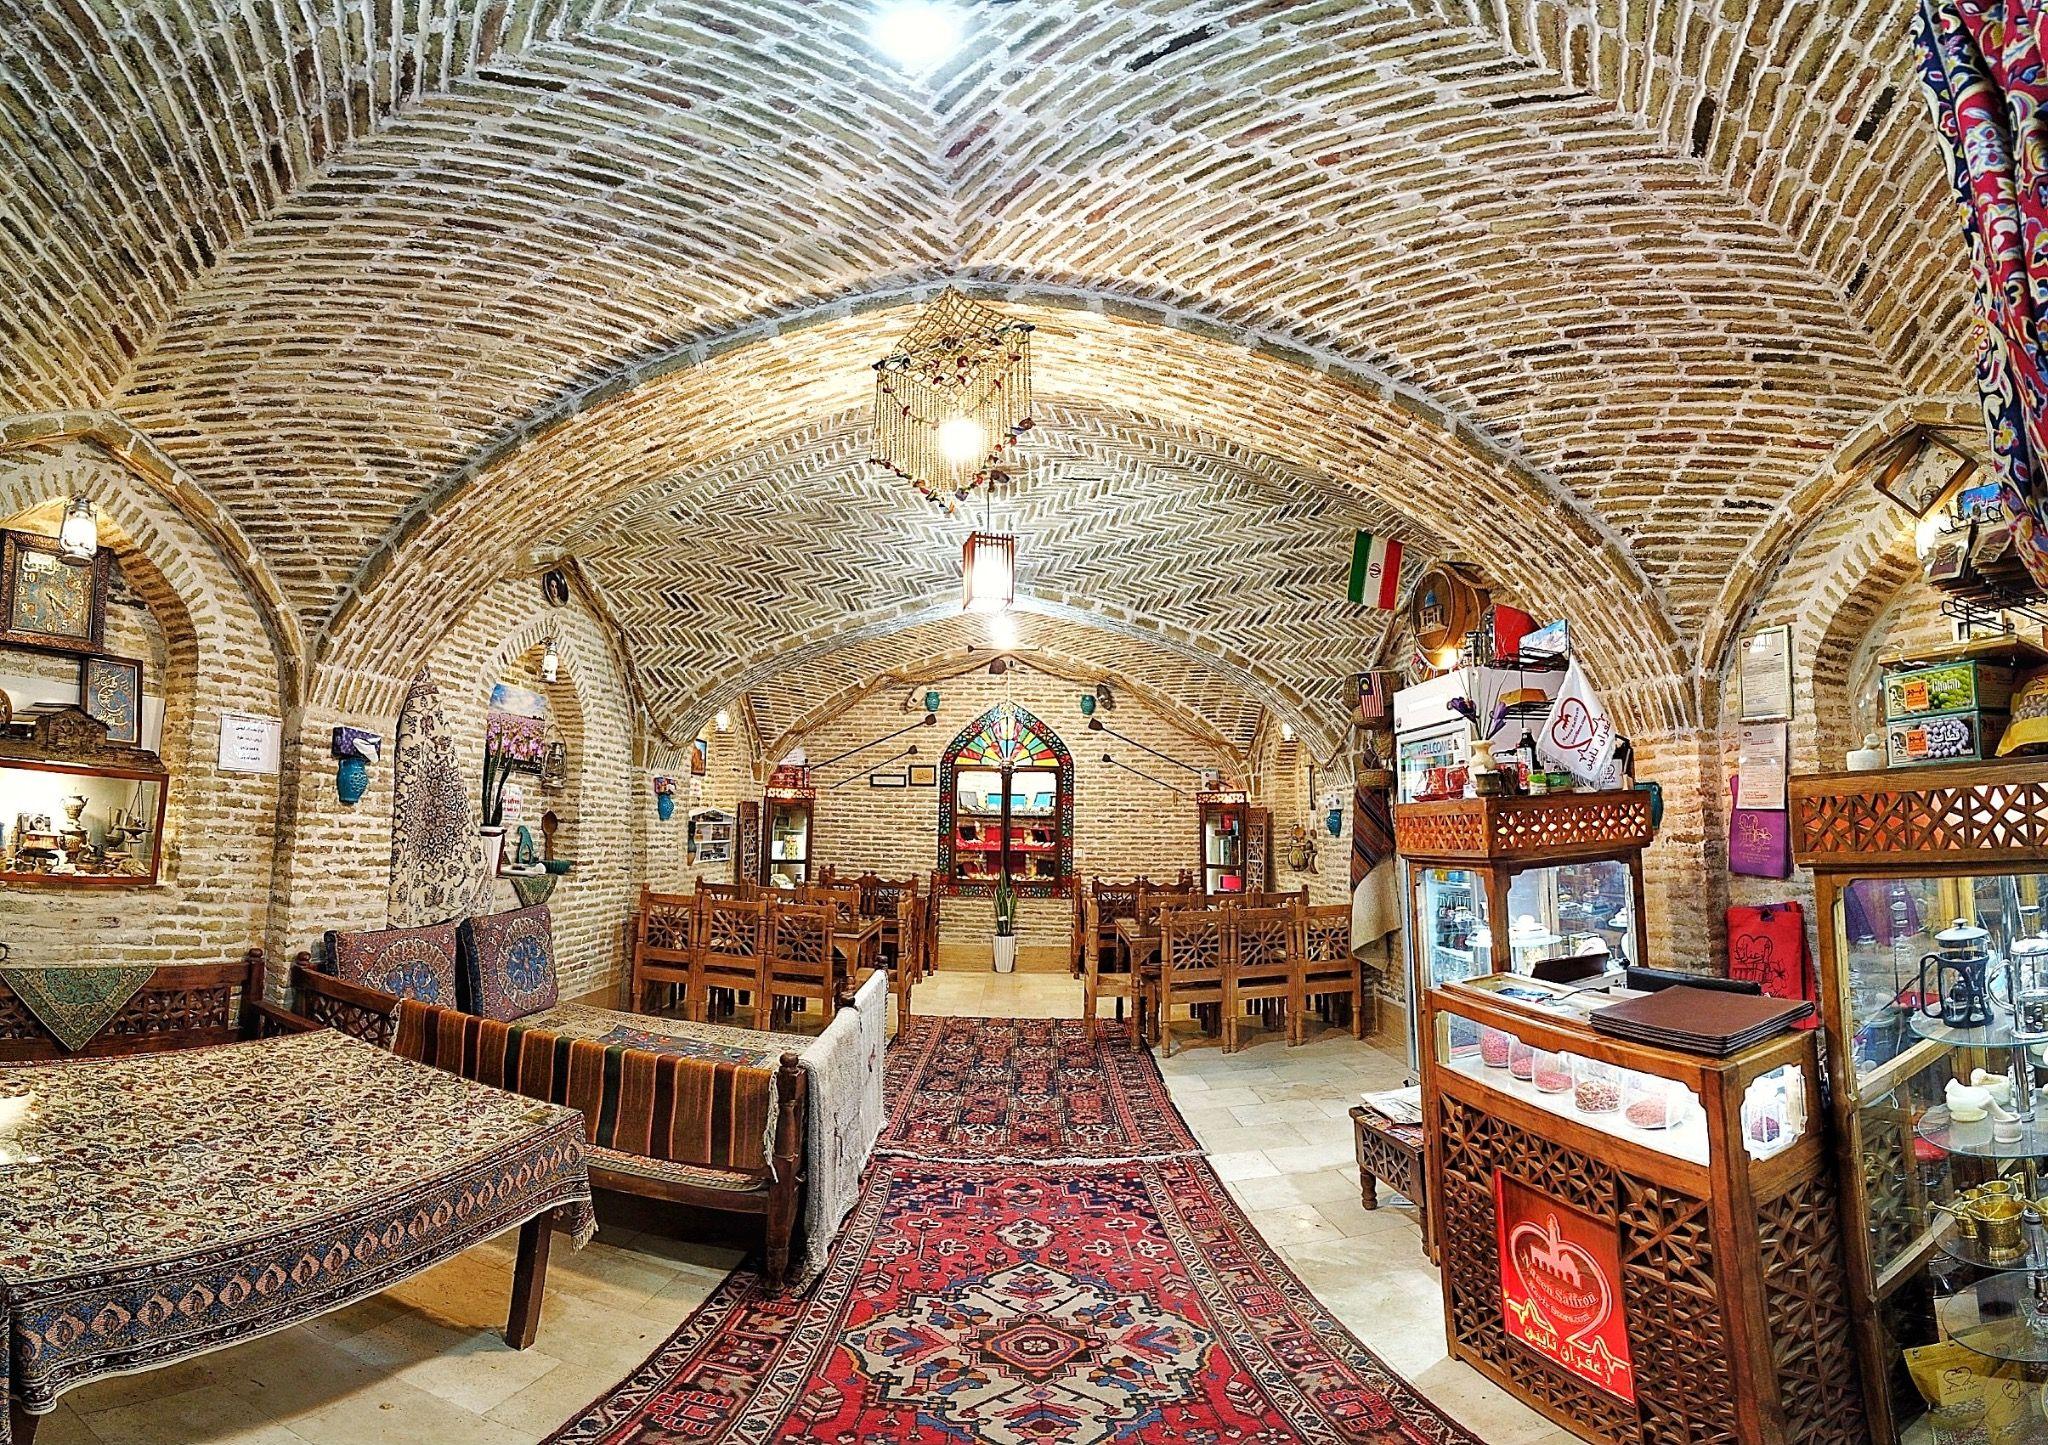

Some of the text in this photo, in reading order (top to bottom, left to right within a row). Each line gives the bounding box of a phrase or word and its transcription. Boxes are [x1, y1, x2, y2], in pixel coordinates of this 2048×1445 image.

[23, 572, 36, 583] 10
[18, 585, 26, 596] 9
[78, 595, 85, 606] 3
[21, 602, 28, 613] 8
[1555, 1289, 1598, 1309] Saffron
[1559, 1345, 1613, 1386] زعفران
